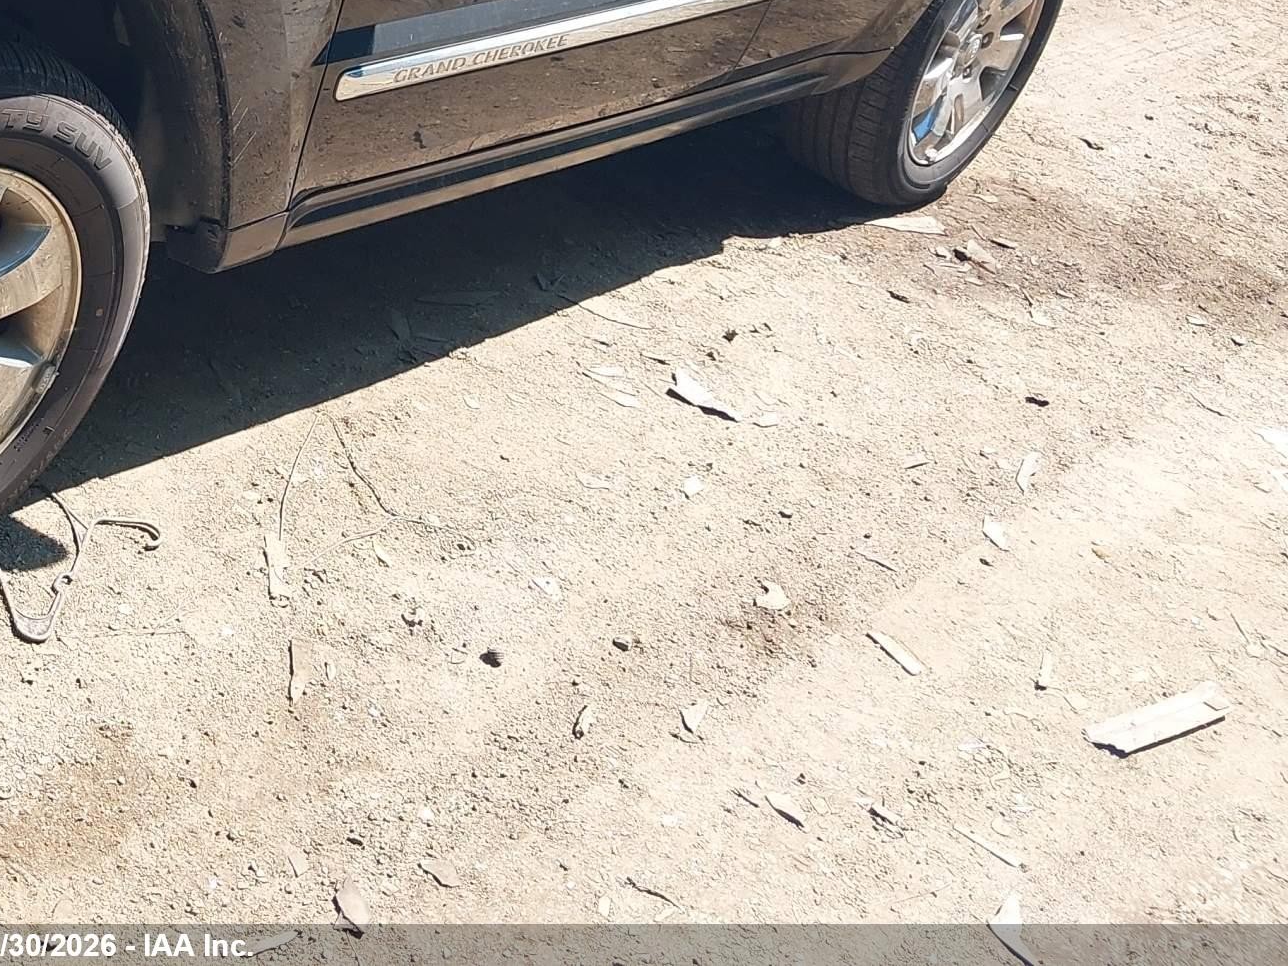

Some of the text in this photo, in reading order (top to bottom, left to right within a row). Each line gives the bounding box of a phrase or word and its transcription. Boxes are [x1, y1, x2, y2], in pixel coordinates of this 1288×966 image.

[392, 35, 569, 84] GRAND CHEROKEE
[51, 120, 113, 172] SUV
